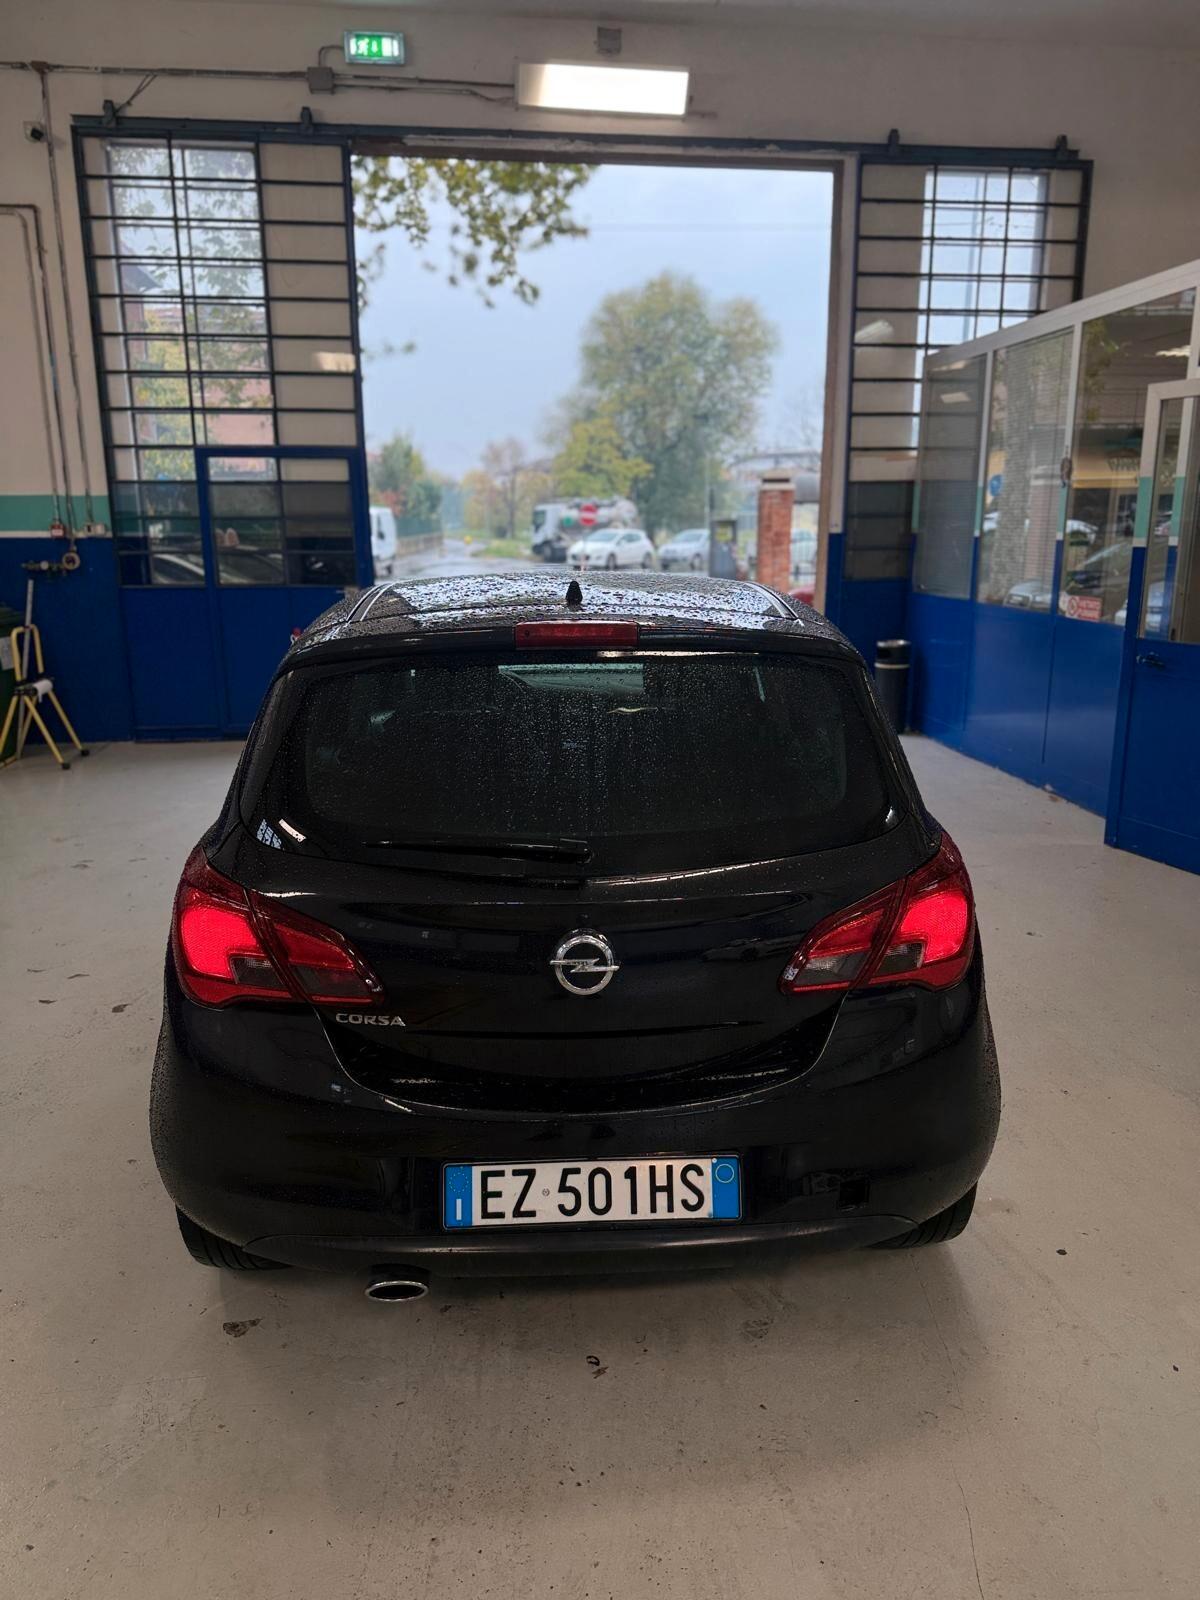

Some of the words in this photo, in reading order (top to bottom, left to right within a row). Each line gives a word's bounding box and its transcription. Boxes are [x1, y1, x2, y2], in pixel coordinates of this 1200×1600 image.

[335, 1012, 406, 1027] CORSA
[480, 1168, 537, 1220] EZ
[456, 1198, 463, 1221] I
